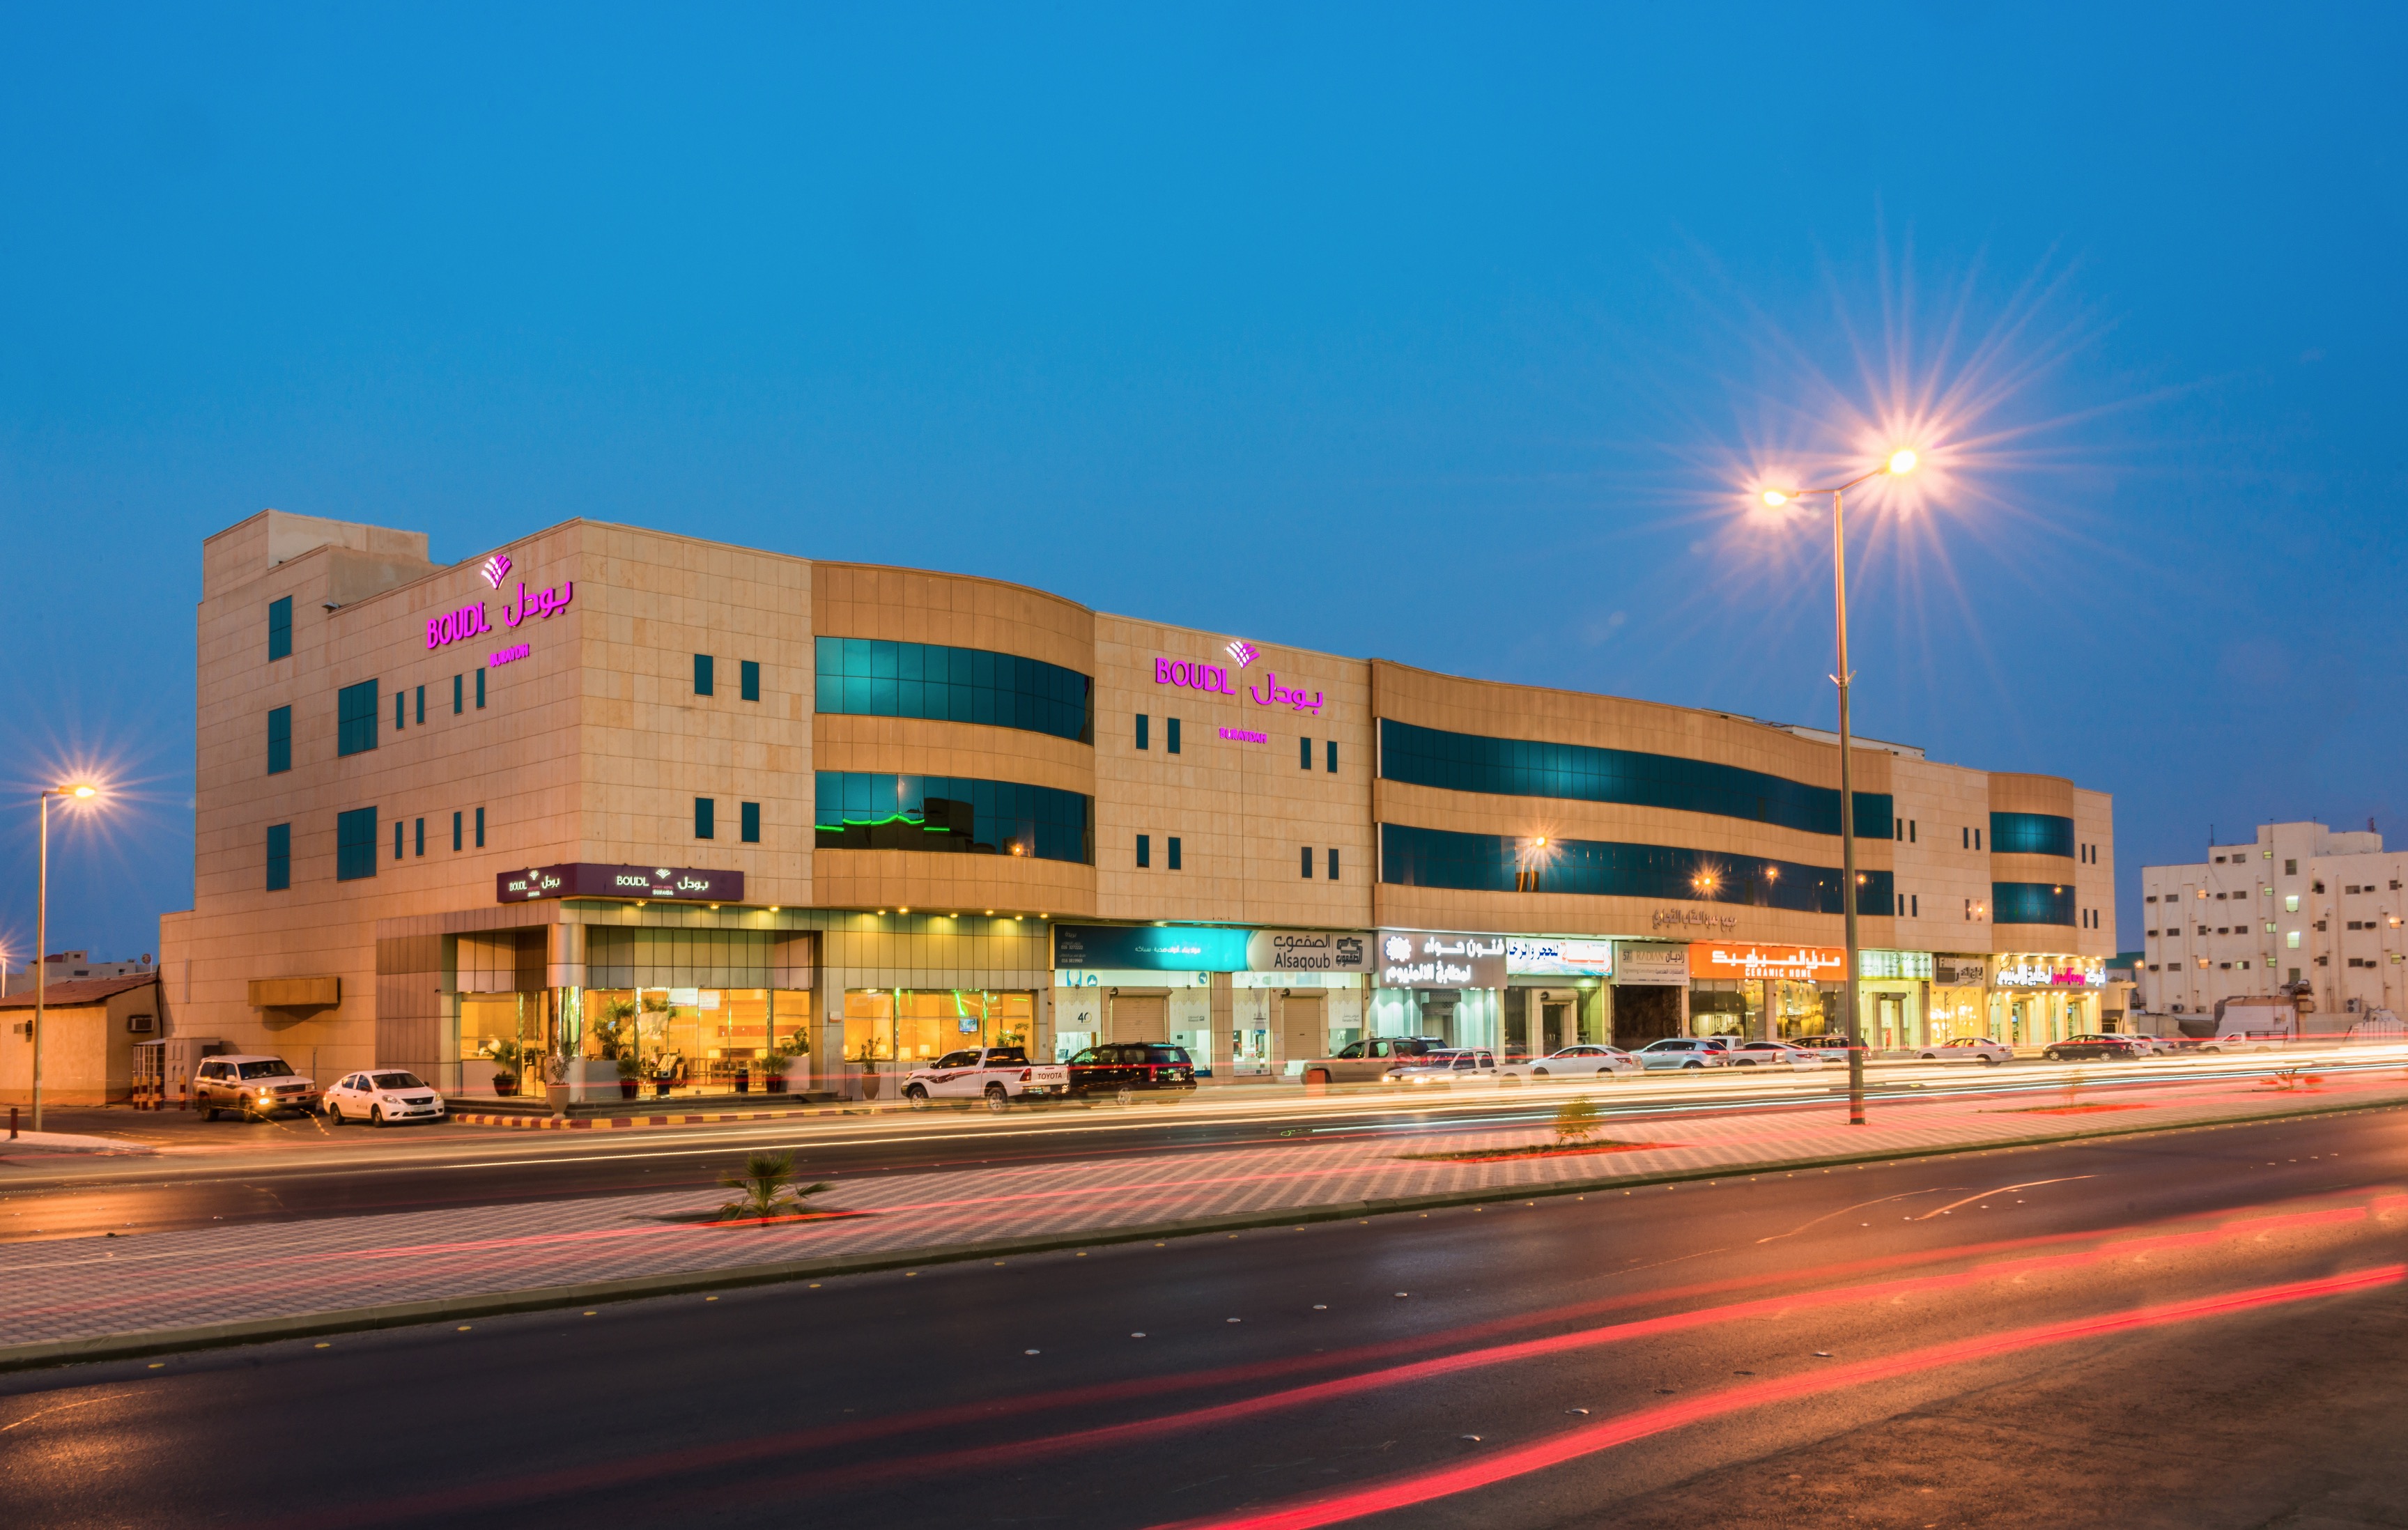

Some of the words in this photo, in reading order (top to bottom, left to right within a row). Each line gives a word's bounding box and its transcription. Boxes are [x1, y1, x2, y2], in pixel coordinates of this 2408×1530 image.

[504, 581, 573, 627] بودل
[427, 601, 491, 649] BOUDL
[1155, 658, 1236, 695] BOUDL
[1250, 673, 1323, 715] بودل
[1219, 727, 1267, 743] BURAYDAH
[617, 875, 649, 886] BOUDL
[677, 876, 709, 890] بودل
[1274, 934, 1330, 952] الصقعوب
[1424, 936, 1465, 957] حواء
[1466, 938, 1505, 958] فنون
[1506, 942, 1534, 960] والرخا
[1536, 944, 1559, 960] للحجر
[1274, 952, 1330, 971] Alsaqoub
[1637, 951, 1664, 961] RADIAN
[1665, 950, 1685, 963] راديان
[1712, 948, 1805, 968] السيراميك
[1805, 950, 1841, 969] منزل
[1435, 960, 1472, 984] لمطابخ
[1745, 967, 1784, 978] CERAMIC
[1789, 968, 1812, 978] HOME
[2085, 966, 2106, 987] شركة
